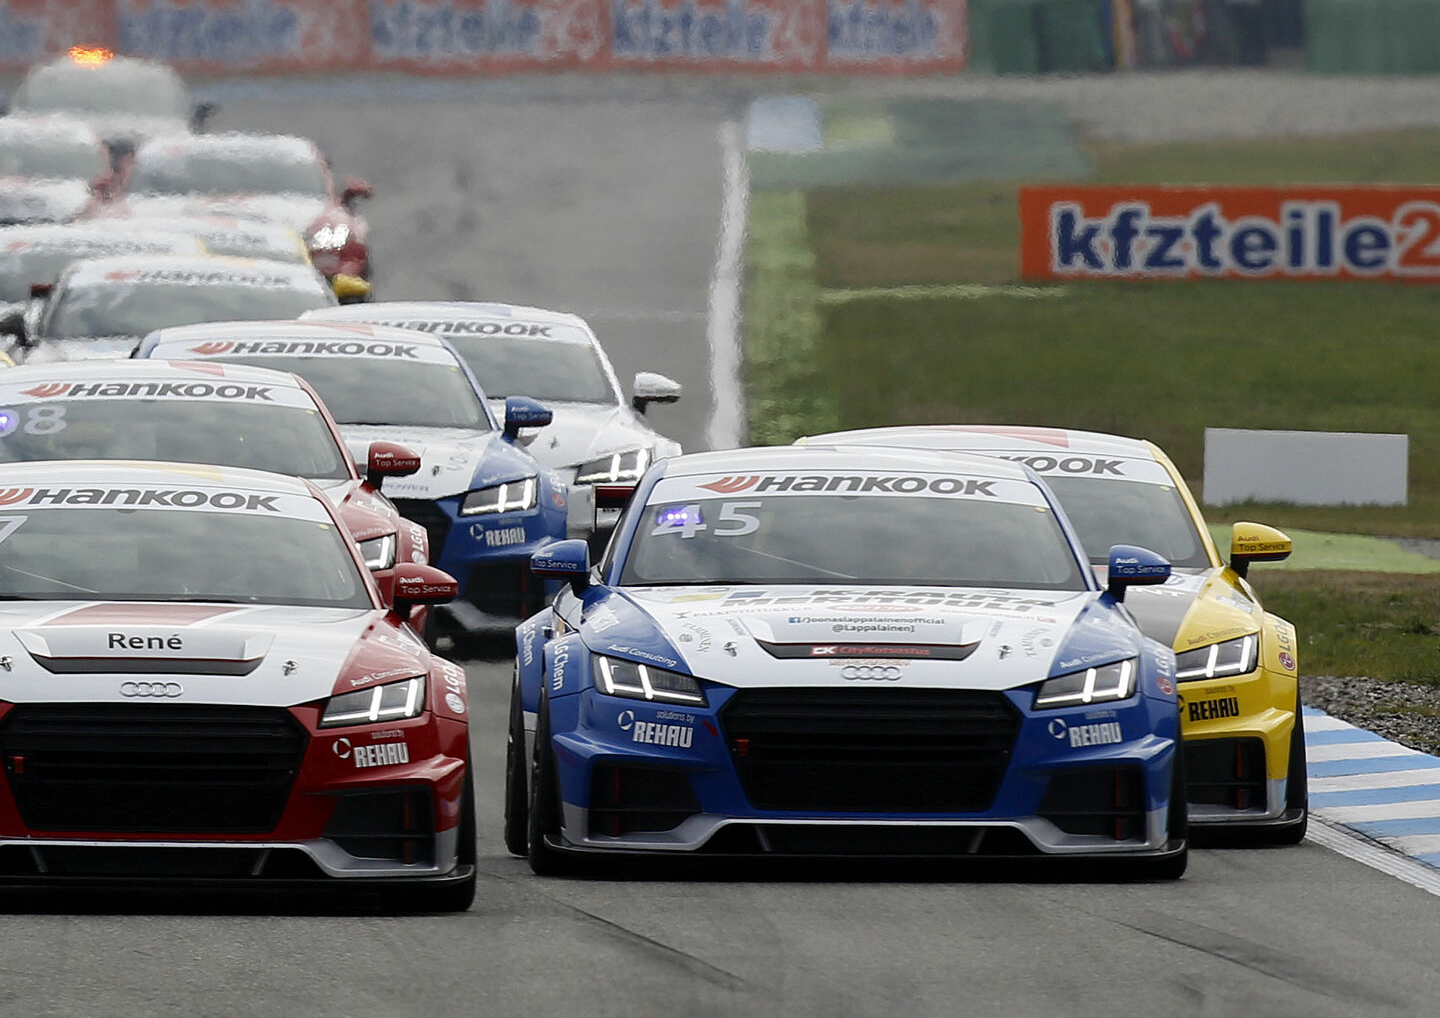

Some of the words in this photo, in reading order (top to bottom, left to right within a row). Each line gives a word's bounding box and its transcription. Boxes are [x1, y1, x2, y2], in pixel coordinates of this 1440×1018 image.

[651, 501, 763, 539] 45
[1238, 543, 1257, 552] Top
[547, 560, 578, 570] Service
[1115, 557, 1140, 565] Audi
[1116, 565, 1135, 575] Top
[399, 576, 425, 584] Audi
[401, 585, 421, 595] Top
[422, 584, 452, 594] Service
[108, 633, 184, 650] René
[628, 648, 678, 668] Consulting
[1188, 696, 1240, 722] REHAU
[655, 710, 686, 722] solutions
[685, 713, 696, 724] by
[632, 721, 694, 749] REHAU
[1068, 722, 1123, 748] REHAU
[353, 742, 410, 768] REHAU
